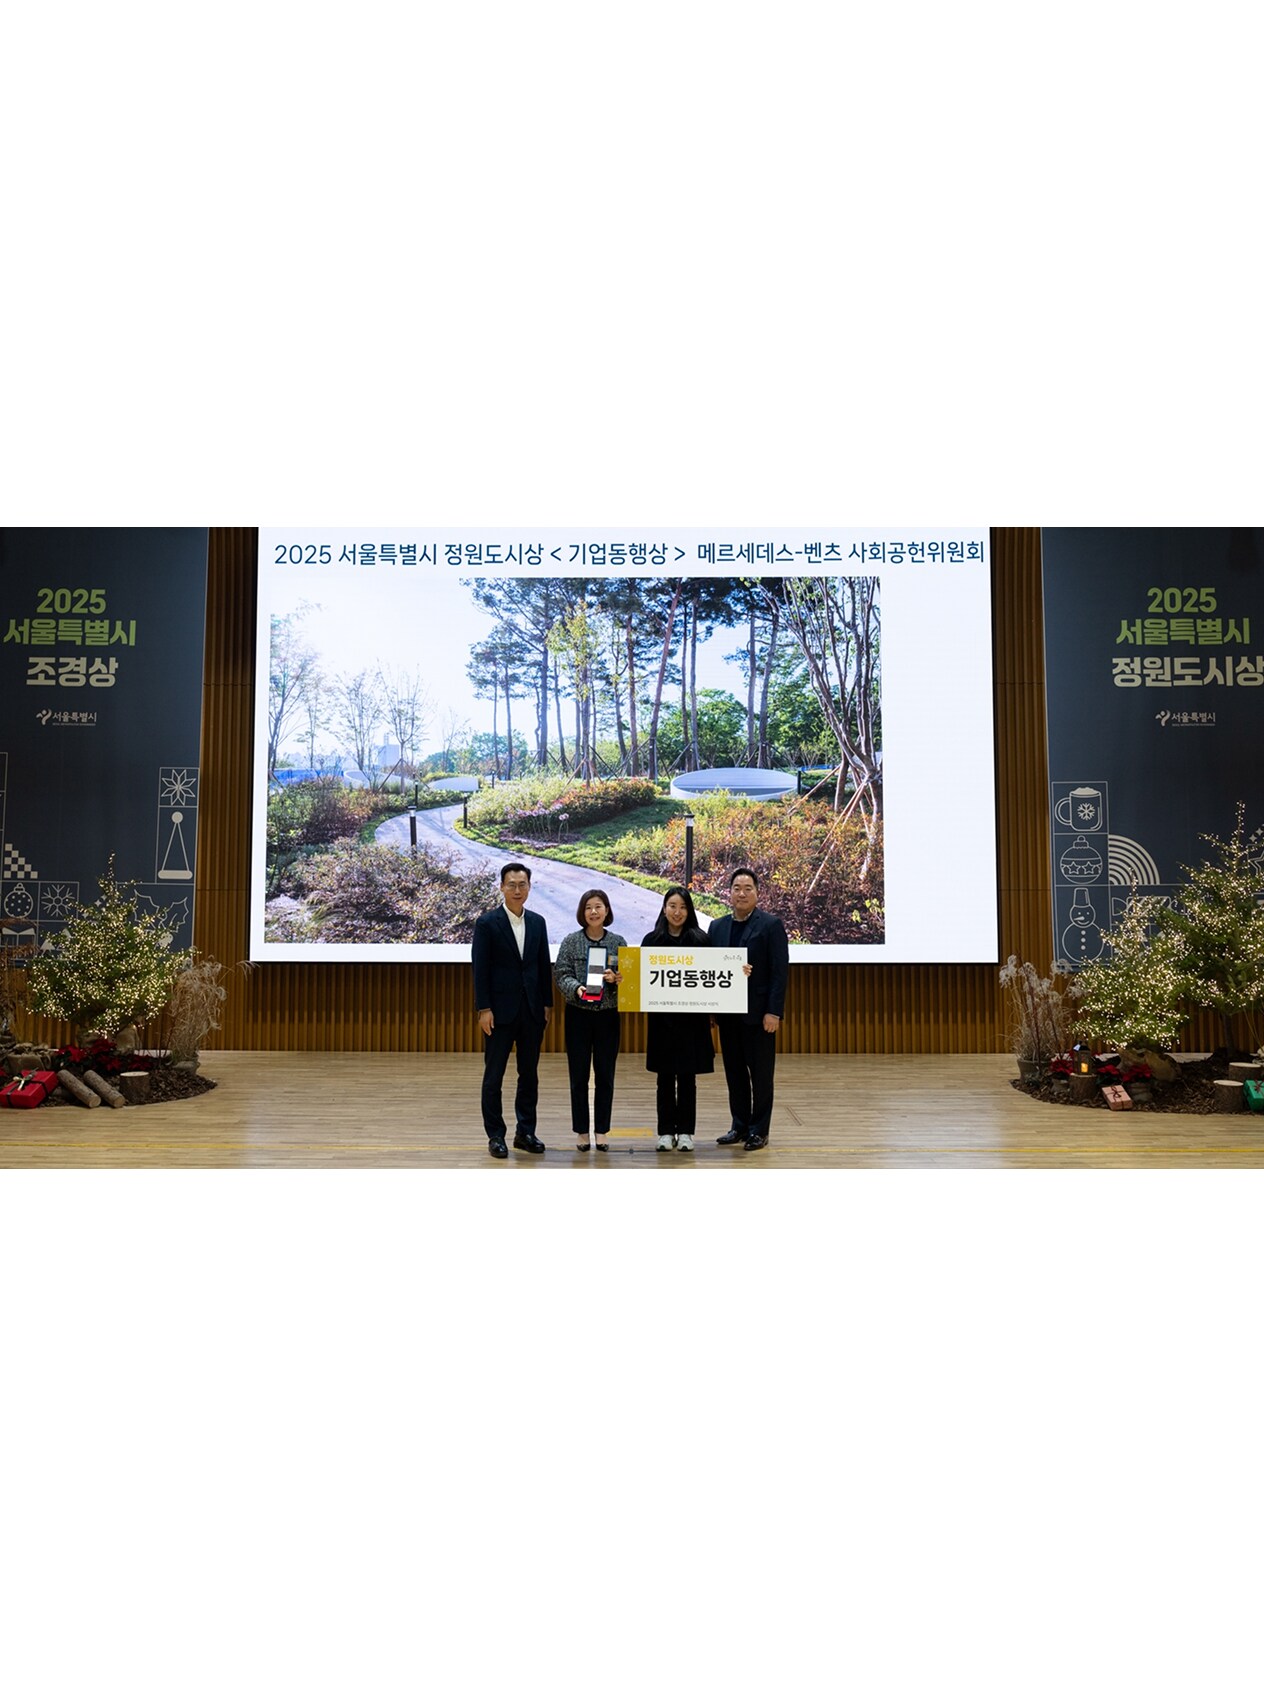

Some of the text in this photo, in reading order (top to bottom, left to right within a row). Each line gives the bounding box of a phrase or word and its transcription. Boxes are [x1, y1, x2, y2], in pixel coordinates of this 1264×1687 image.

[274, 544, 332, 565] 2025
[338, 543, 437, 566] 서울특별시
[444, 543, 545, 566] 정원도시상
[568, 542, 669, 566] 기업동행상
[697, 541, 843, 565] 메르세데스-벤츠
[848, 540, 985, 565] 사회공헌위원회
[36, 588, 107, 614] 2025
[1147, 587, 1217, 613] 2025
[3, 618, 137, 647] 서울특별시
[1115, 617, 1250, 646] 서울특별시
[26, 656, 119, 688] 조경상
[1112, 655, 1264, 688] 정원도시상
[52, 711, 97, 723] 서울특별시
[1171, 711, 1216, 723] 서울특별시
[649, 954, 694, 967] 정원도시상
[649, 969, 734, 989] 기업동행상
